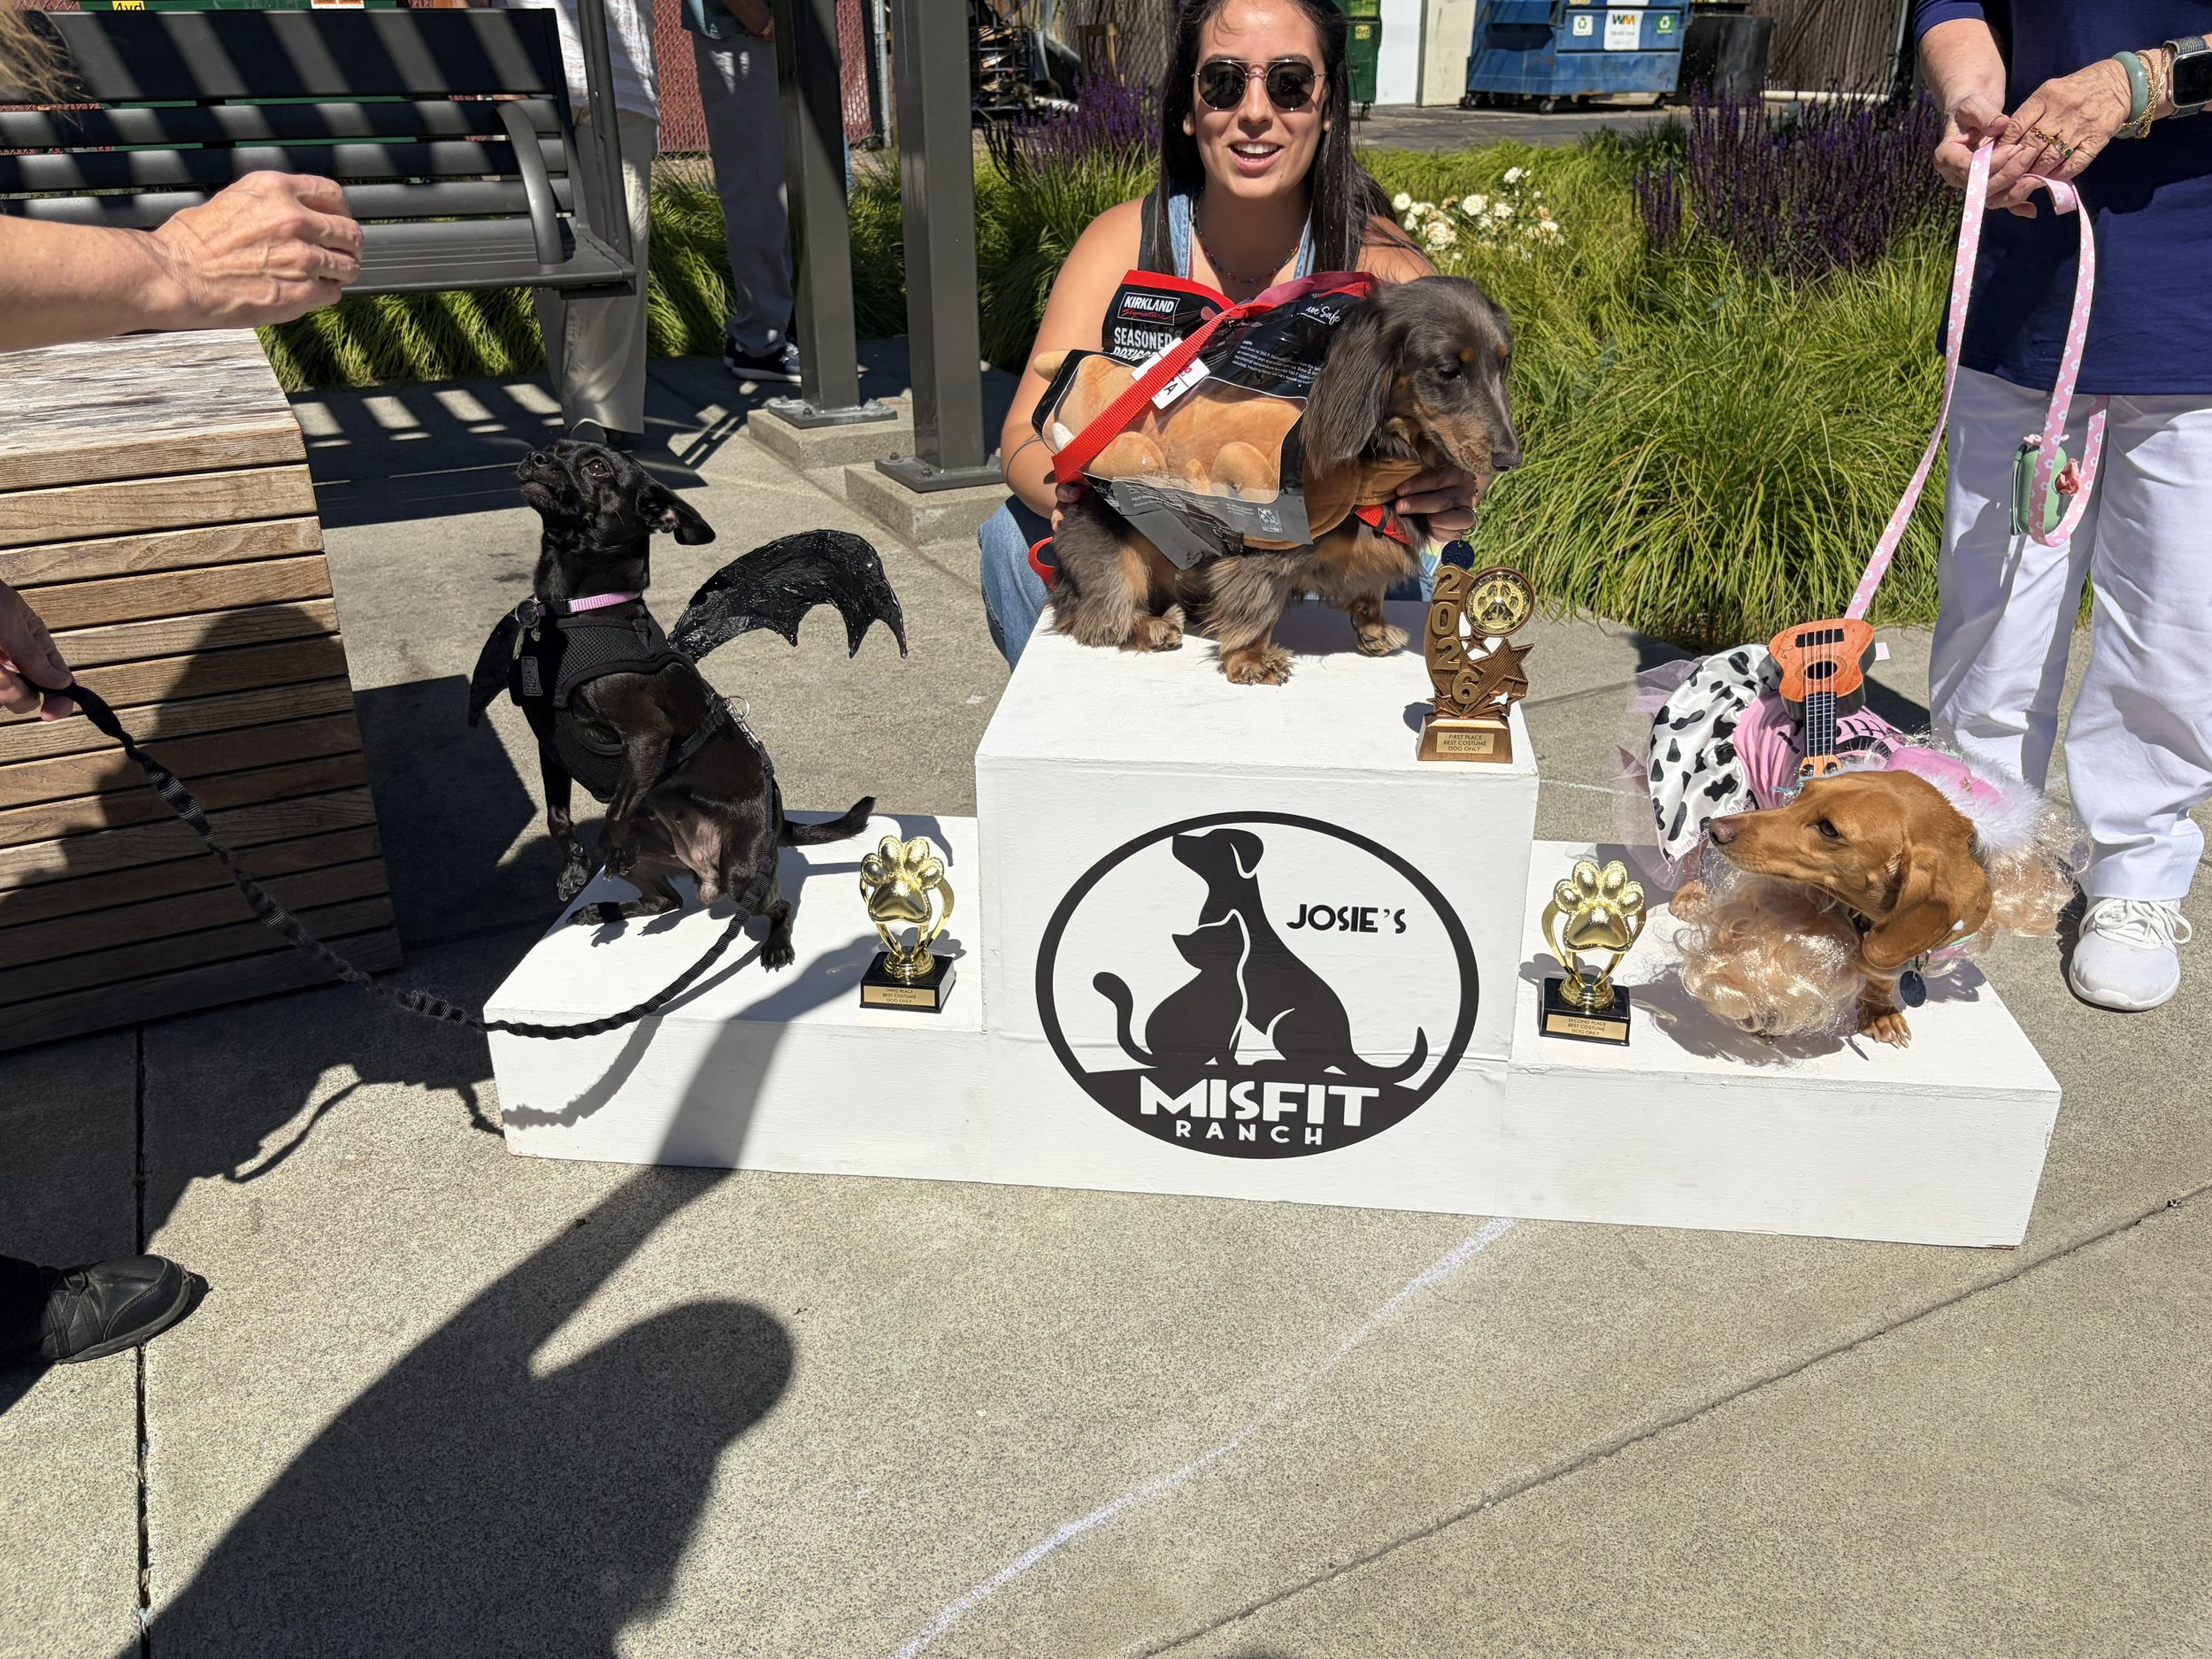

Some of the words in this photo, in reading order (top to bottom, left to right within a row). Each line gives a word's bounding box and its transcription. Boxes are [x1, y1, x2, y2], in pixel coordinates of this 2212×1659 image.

[1124, 296, 1175, 313] KIRKLAND
[1320, 306, 1340, 325] Safe
[1114, 326, 1173, 350] SEASONED
[1286, 903, 1407, 934] JOSIE'S
[1141, 1075, 1379, 1126] MISFIT
[1176, 1120, 1323, 1145] RANCH
